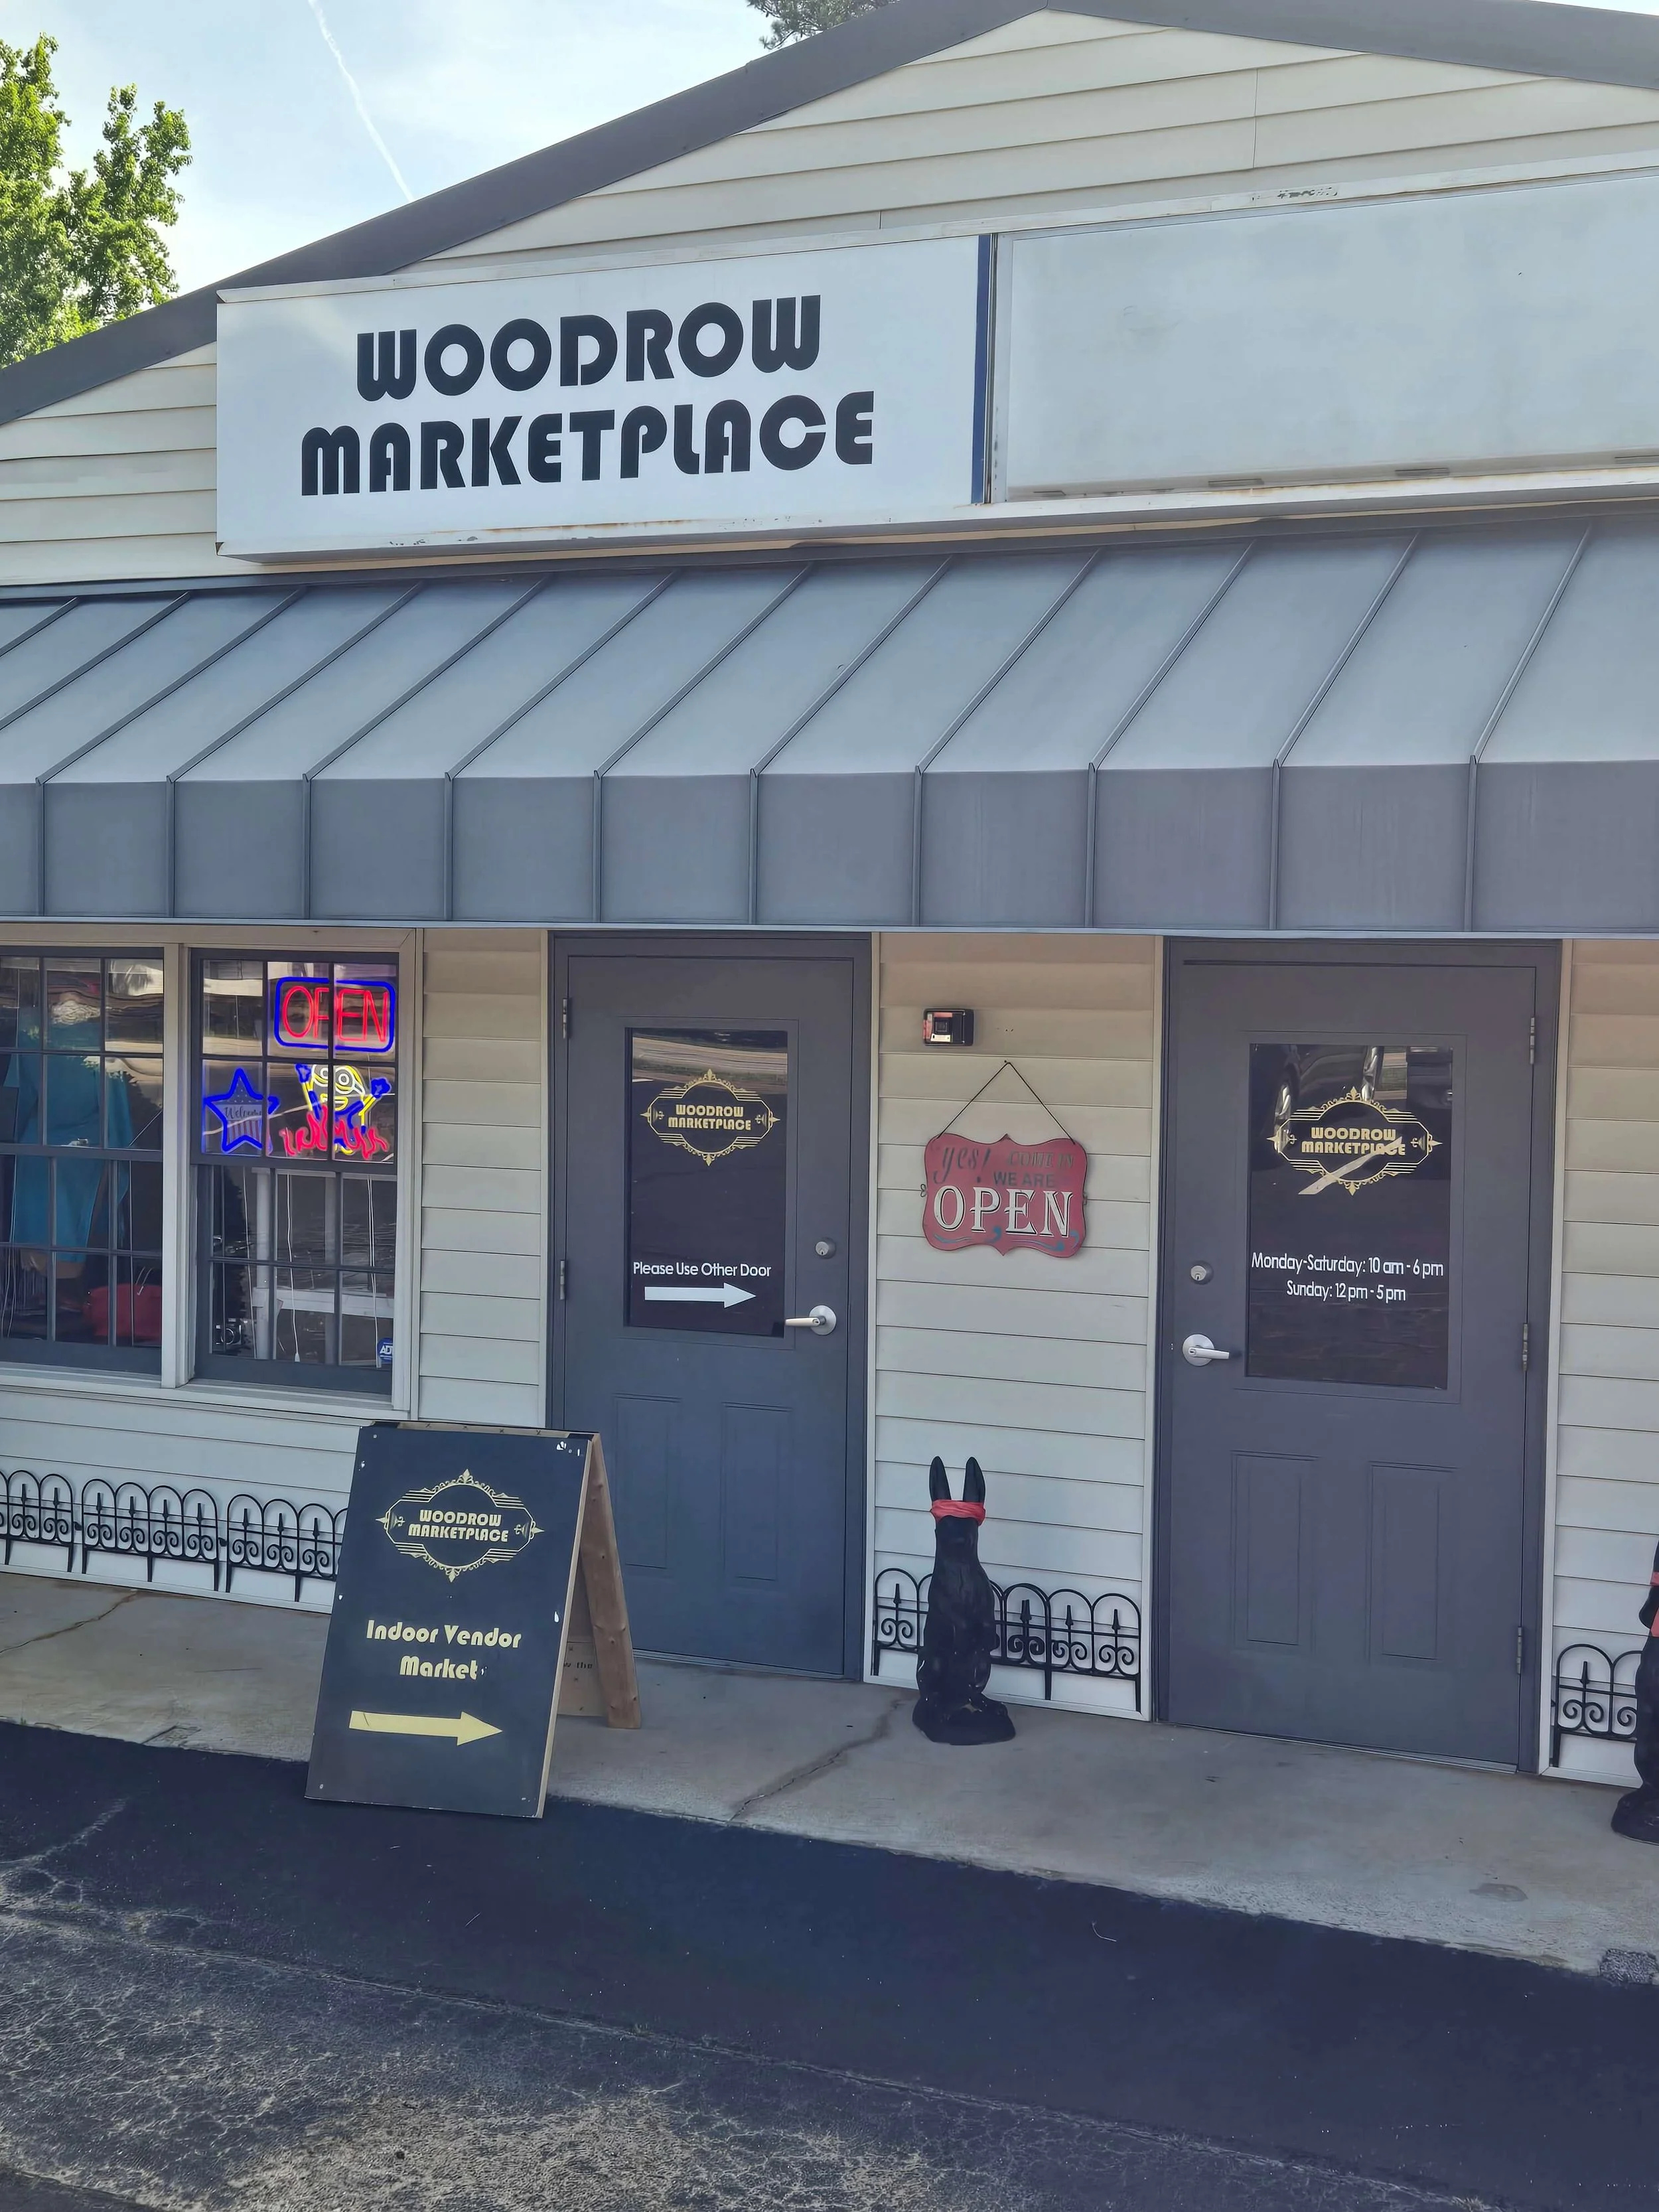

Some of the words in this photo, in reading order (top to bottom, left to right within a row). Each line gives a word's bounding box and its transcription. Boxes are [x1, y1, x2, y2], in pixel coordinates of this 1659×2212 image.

[356, 294, 821, 402] WOODROW
[301, 390, 875, 496] MARKETPLACE
[283, 986, 389, 1042] OPEN
[676, 1104, 744, 1117] WOODROW
[668, 1117, 751, 1130] MARKETPLACE
[1311, 1127, 1396, 1141] WOODROW
[993, 1171, 1018, 1187] WE
[1021, 1172, 1055, 1188] ARE
[934, 1185, 1074, 1237] OPEN
[633, 1262, 674, 1275] Please
[676, 1262, 699, 1276] Use
[701, 1262, 738, 1277] Other
[740, 1264, 772, 1277] Door
[1252, 1252, 1366, 1277] Monday-Saturday:
[1368, 1256, 1381, 1274] 10
[1383, 1262, 1404, 1275] am
[1413, 1259, 1421, 1276] 6
[1422, 1263, 1444, 1279] pm
[1286, 1280, 1333, 1301] Sunday:
[1334, 1282, 1346, 1298] 12
[1348, 1287, 1368, 1302] pm
[1376, 1284, 1384, 1300] 5
[1386, 1287, 1406, 1304] pm
[419, 1509, 502, 1526] WOODROW
[408, 1524, 508, 1542] MARKETPLACE
[366, 1619, 439, 1643] Indoor
[444, 1625, 522, 1648] Vendor
[399, 1655, 478, 1680] Market
